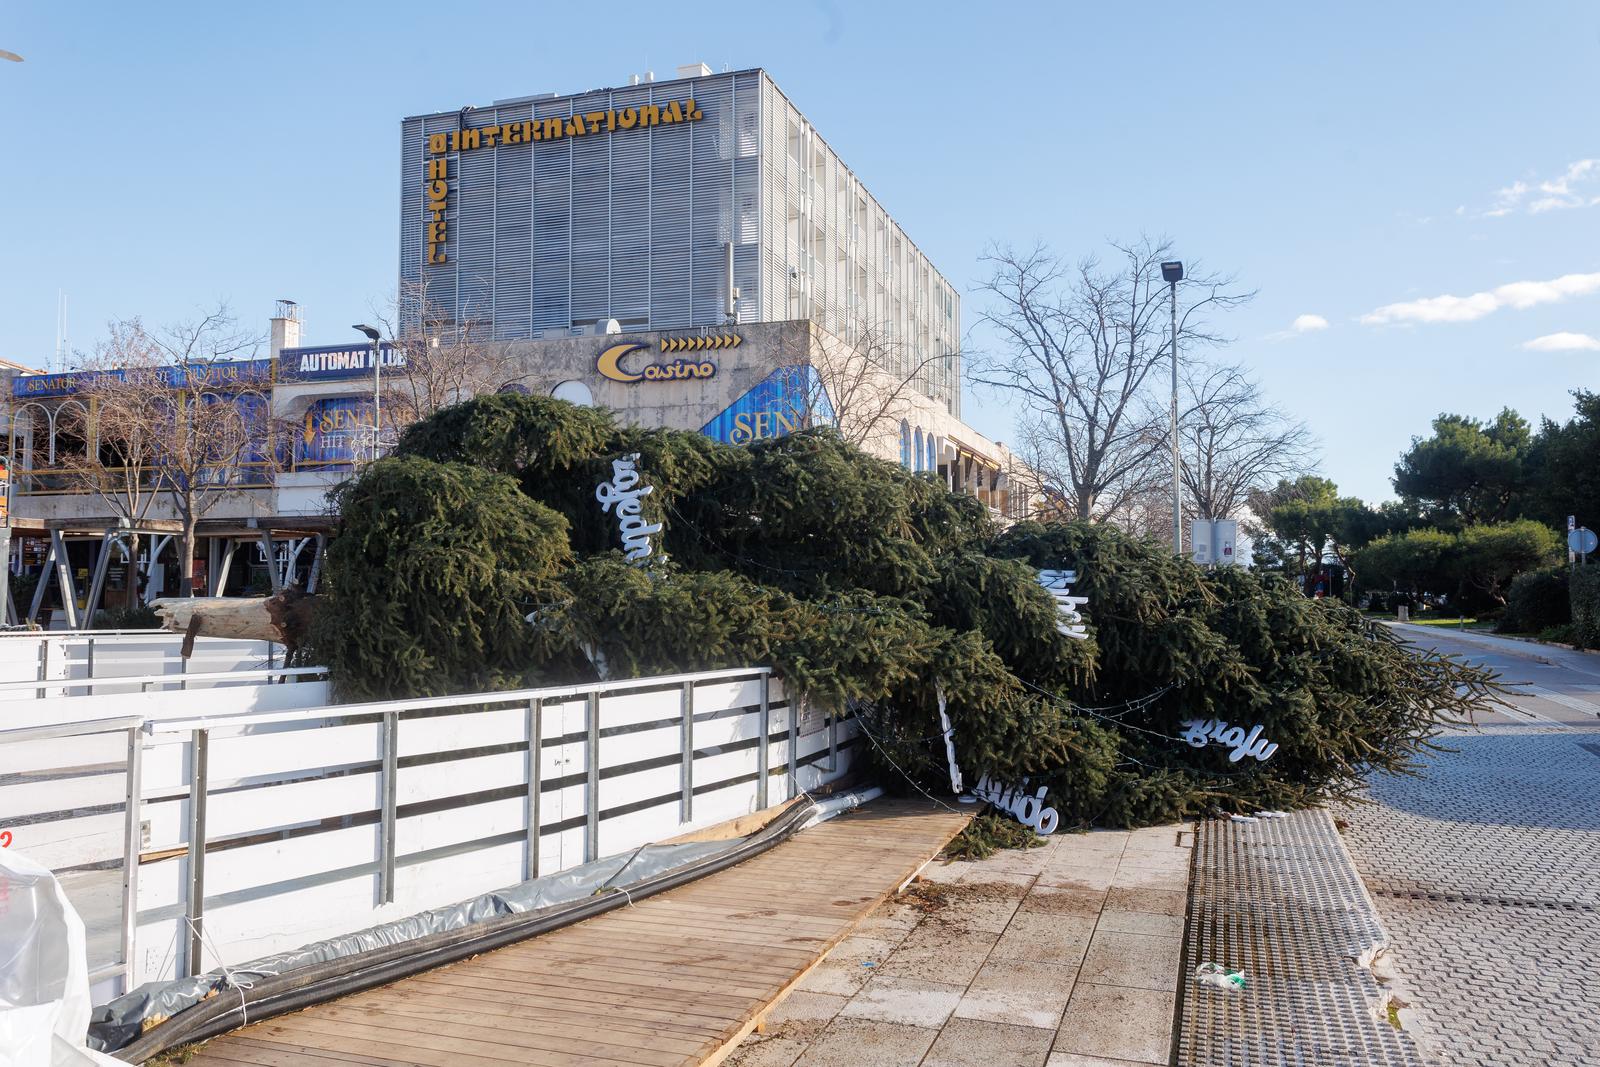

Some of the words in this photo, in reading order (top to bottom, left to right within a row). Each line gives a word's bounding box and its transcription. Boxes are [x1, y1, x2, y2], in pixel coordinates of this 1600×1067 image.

[452, 98, 703, 151] INTERNATIONAL
[428, 158, 448, 265] HOTEL
[299, 350, 366, 372] AUTOMAT
[597, 343, 716, 382] Casino
[27, 377, 76, 392] SENATOR
[321, 434, 346, 449] HIT
